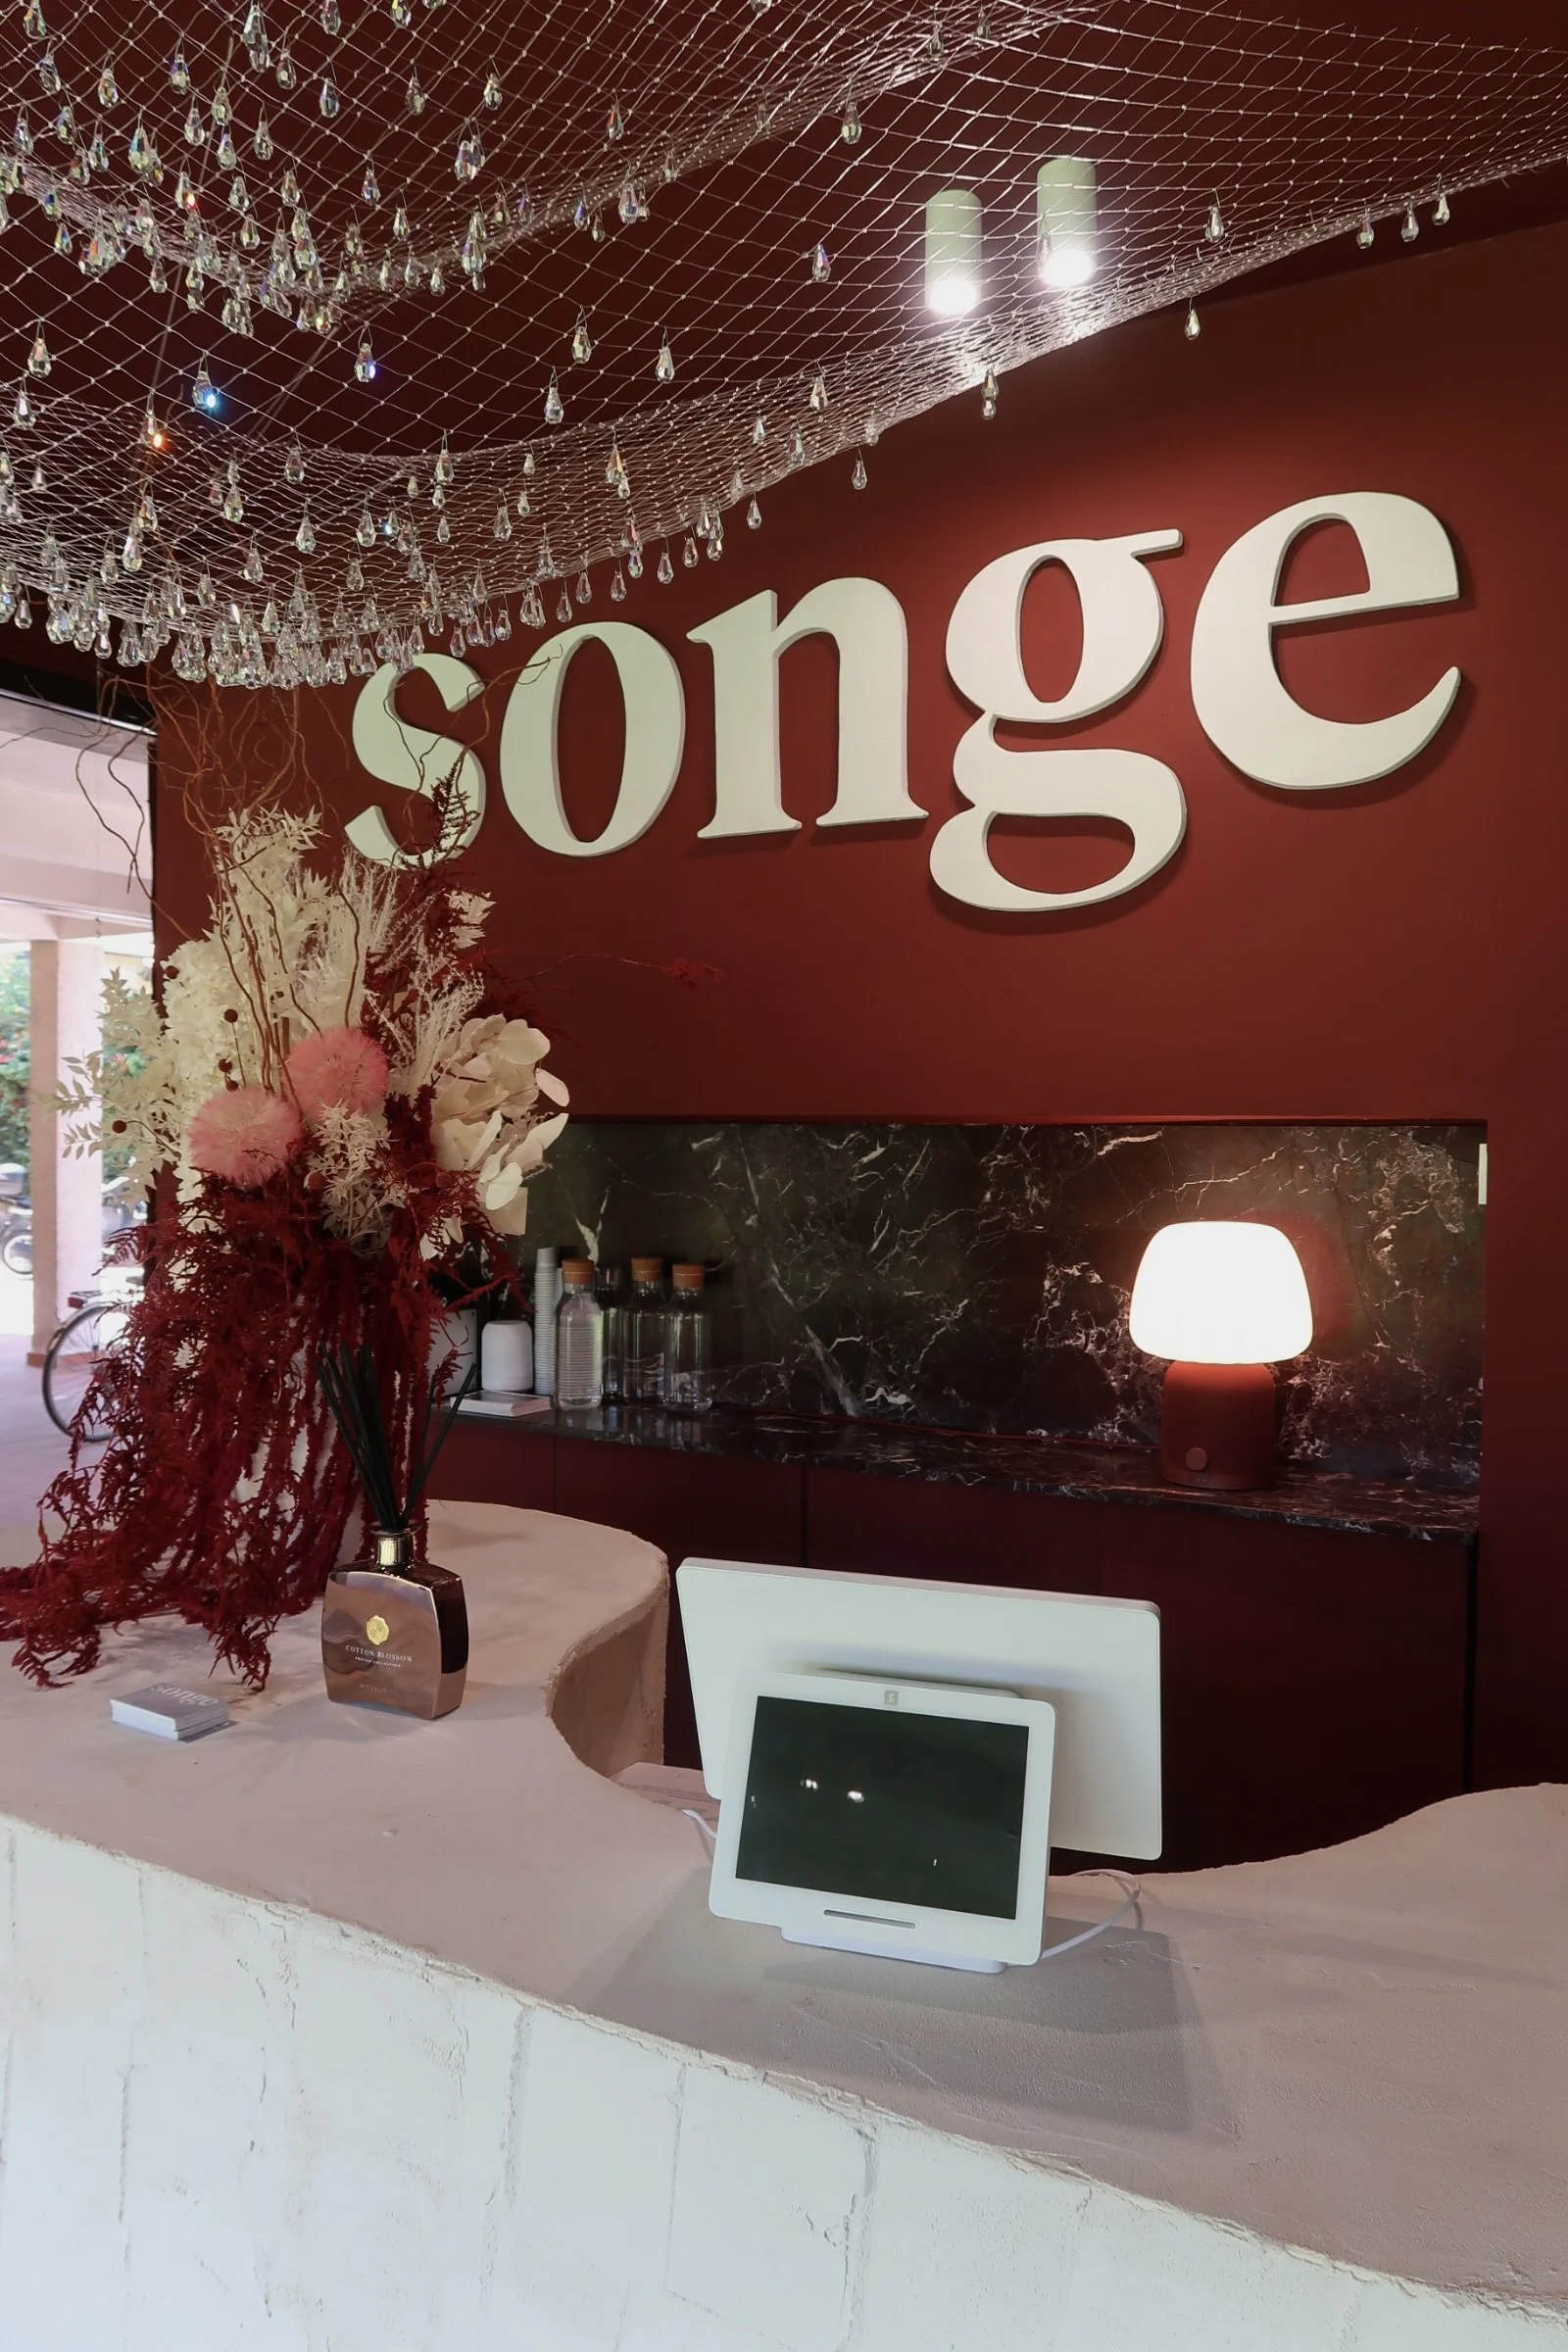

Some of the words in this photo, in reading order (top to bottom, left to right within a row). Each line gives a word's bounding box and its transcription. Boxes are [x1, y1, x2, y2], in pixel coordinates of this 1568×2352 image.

[344, 491, 1460, 912] songe
[345, 1644, 374, 1656] COTTON
[377, 1650, 412, 1663] BLOSSOM
